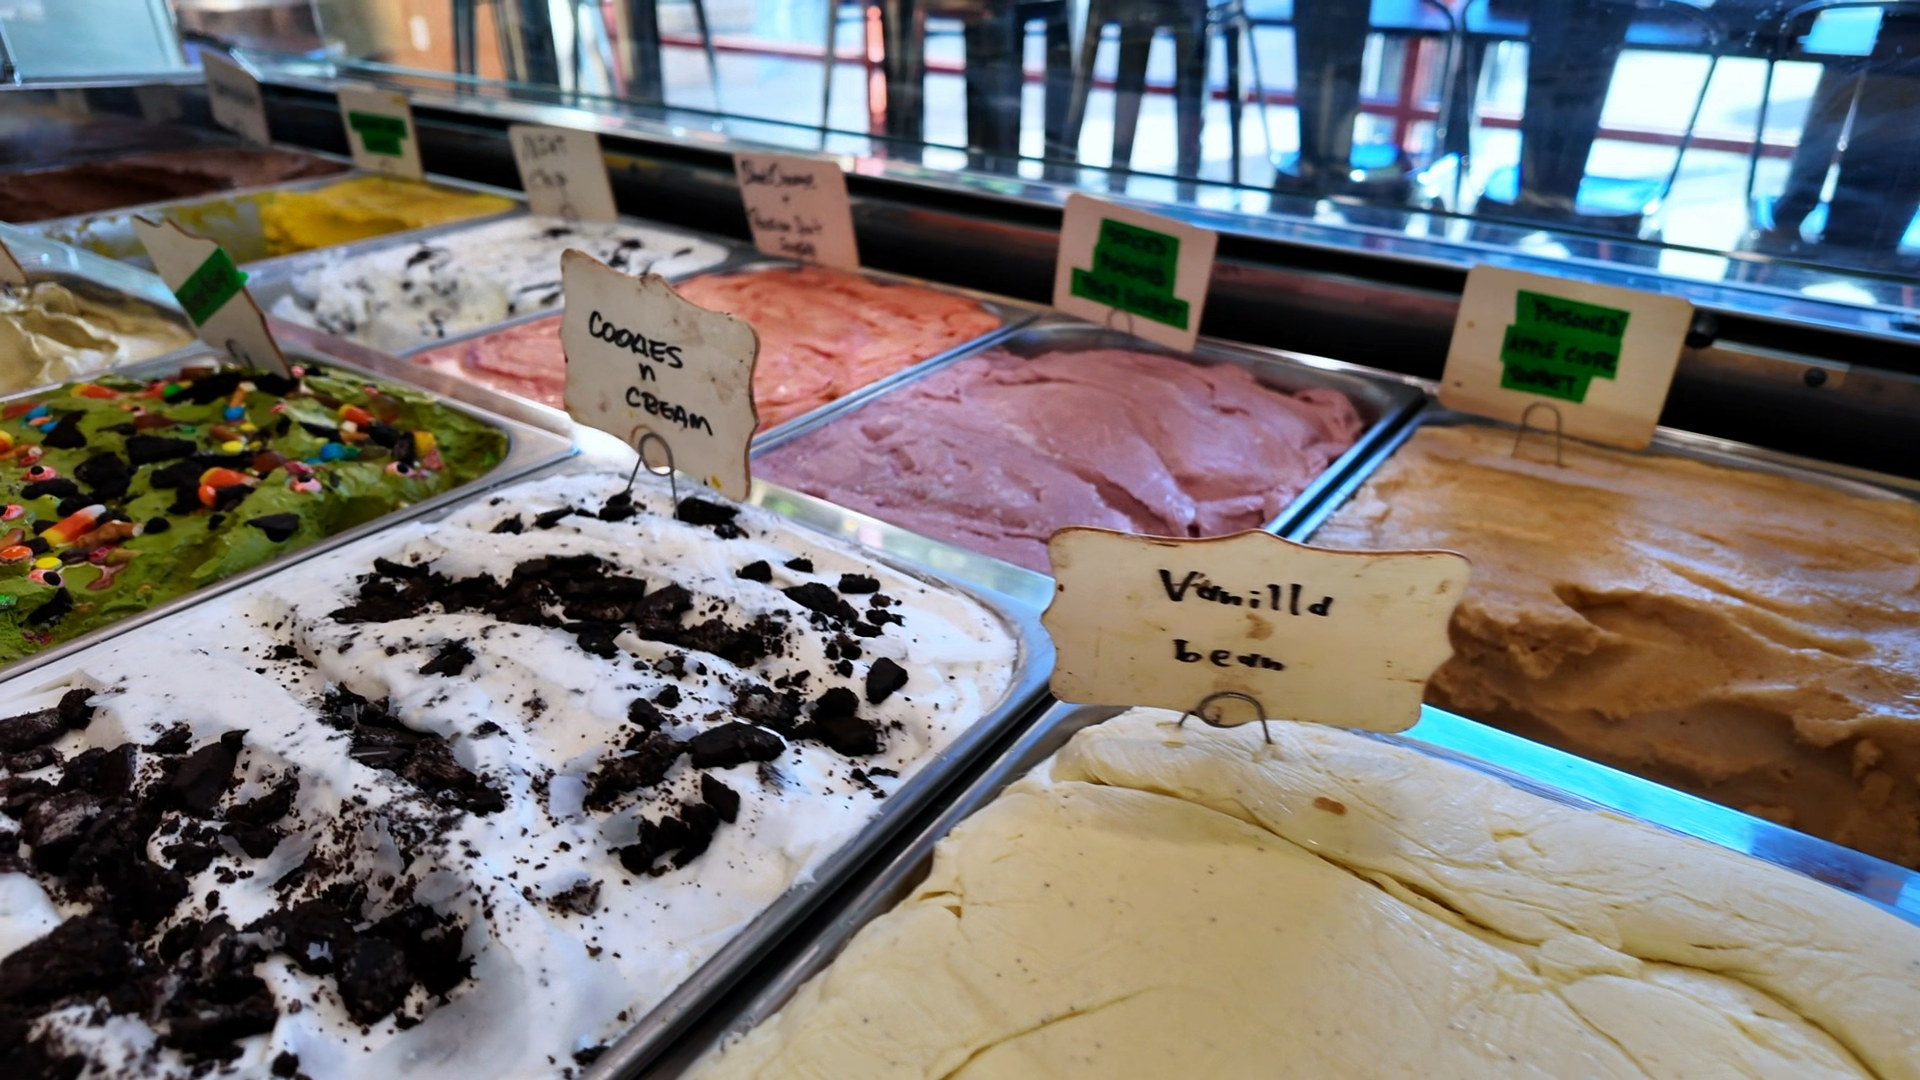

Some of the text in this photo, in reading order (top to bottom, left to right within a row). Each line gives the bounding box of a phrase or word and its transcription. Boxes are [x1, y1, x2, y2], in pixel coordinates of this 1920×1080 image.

[625, 386, 714, 437] CREAM
[1158, 568, 1334, 617] Vanilla
[1173, 638, 1287, 672] bean
